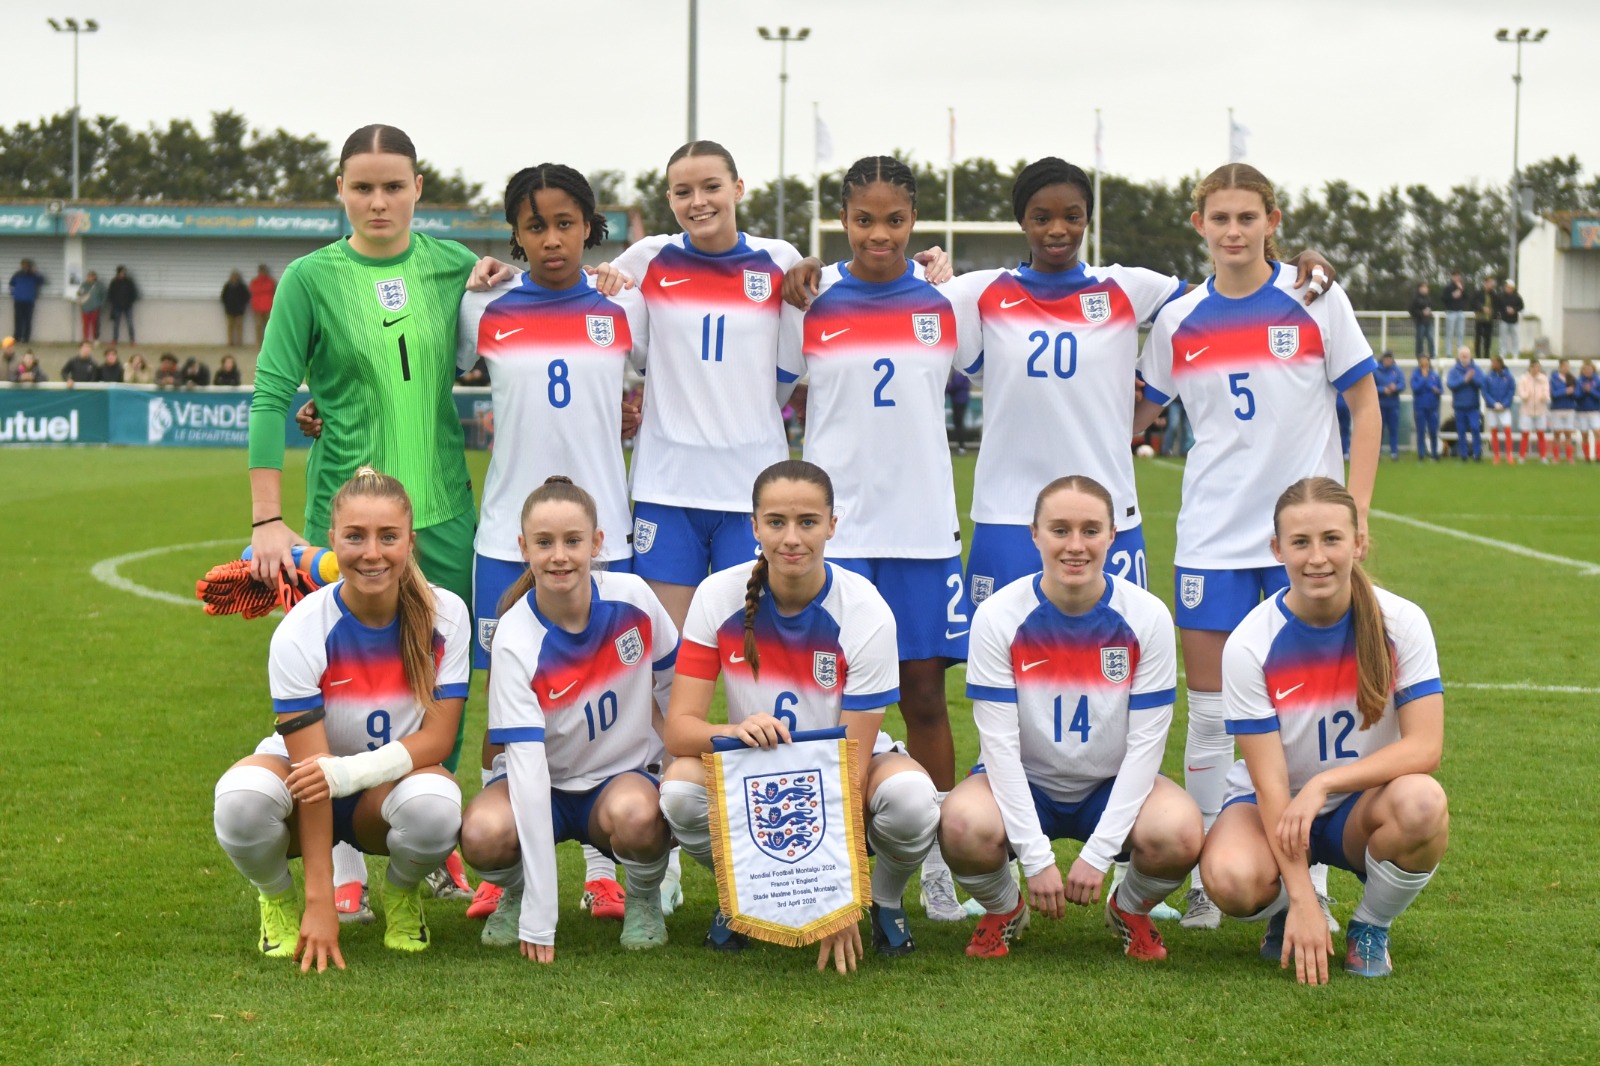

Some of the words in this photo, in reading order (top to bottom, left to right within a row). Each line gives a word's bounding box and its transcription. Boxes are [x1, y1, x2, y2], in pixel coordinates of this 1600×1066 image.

[99, 213, 183, 229] MONDIAL
[397, 333, 411, 382] 1
[701, 313, 725, 362] 11
[1027, 330, 1077, 380] 20
[548, 359, 571, 409] 8
[873, 358, 896, 407] 2
[1228, 372, 1256, 421] 5
[0, 409, 79, 441] utuel
[1111, 549, 1148, 592] 20
[946, 573, 968, 623] 2
[366, 709, 393, 752] 9
[583, 689, 618, 743] 10
[773, 691, 799, 732] 6
[1053, 694, 1093, 743] 14
[1318, 709, 1360, 762] 12
[750, 872, 771, 880] Mondial
[772, 868, 794, 877] Football
[753, 893, 769, 901] Stade
[796, 877, 818, 885] England
[788, 899, 801, 907] April
